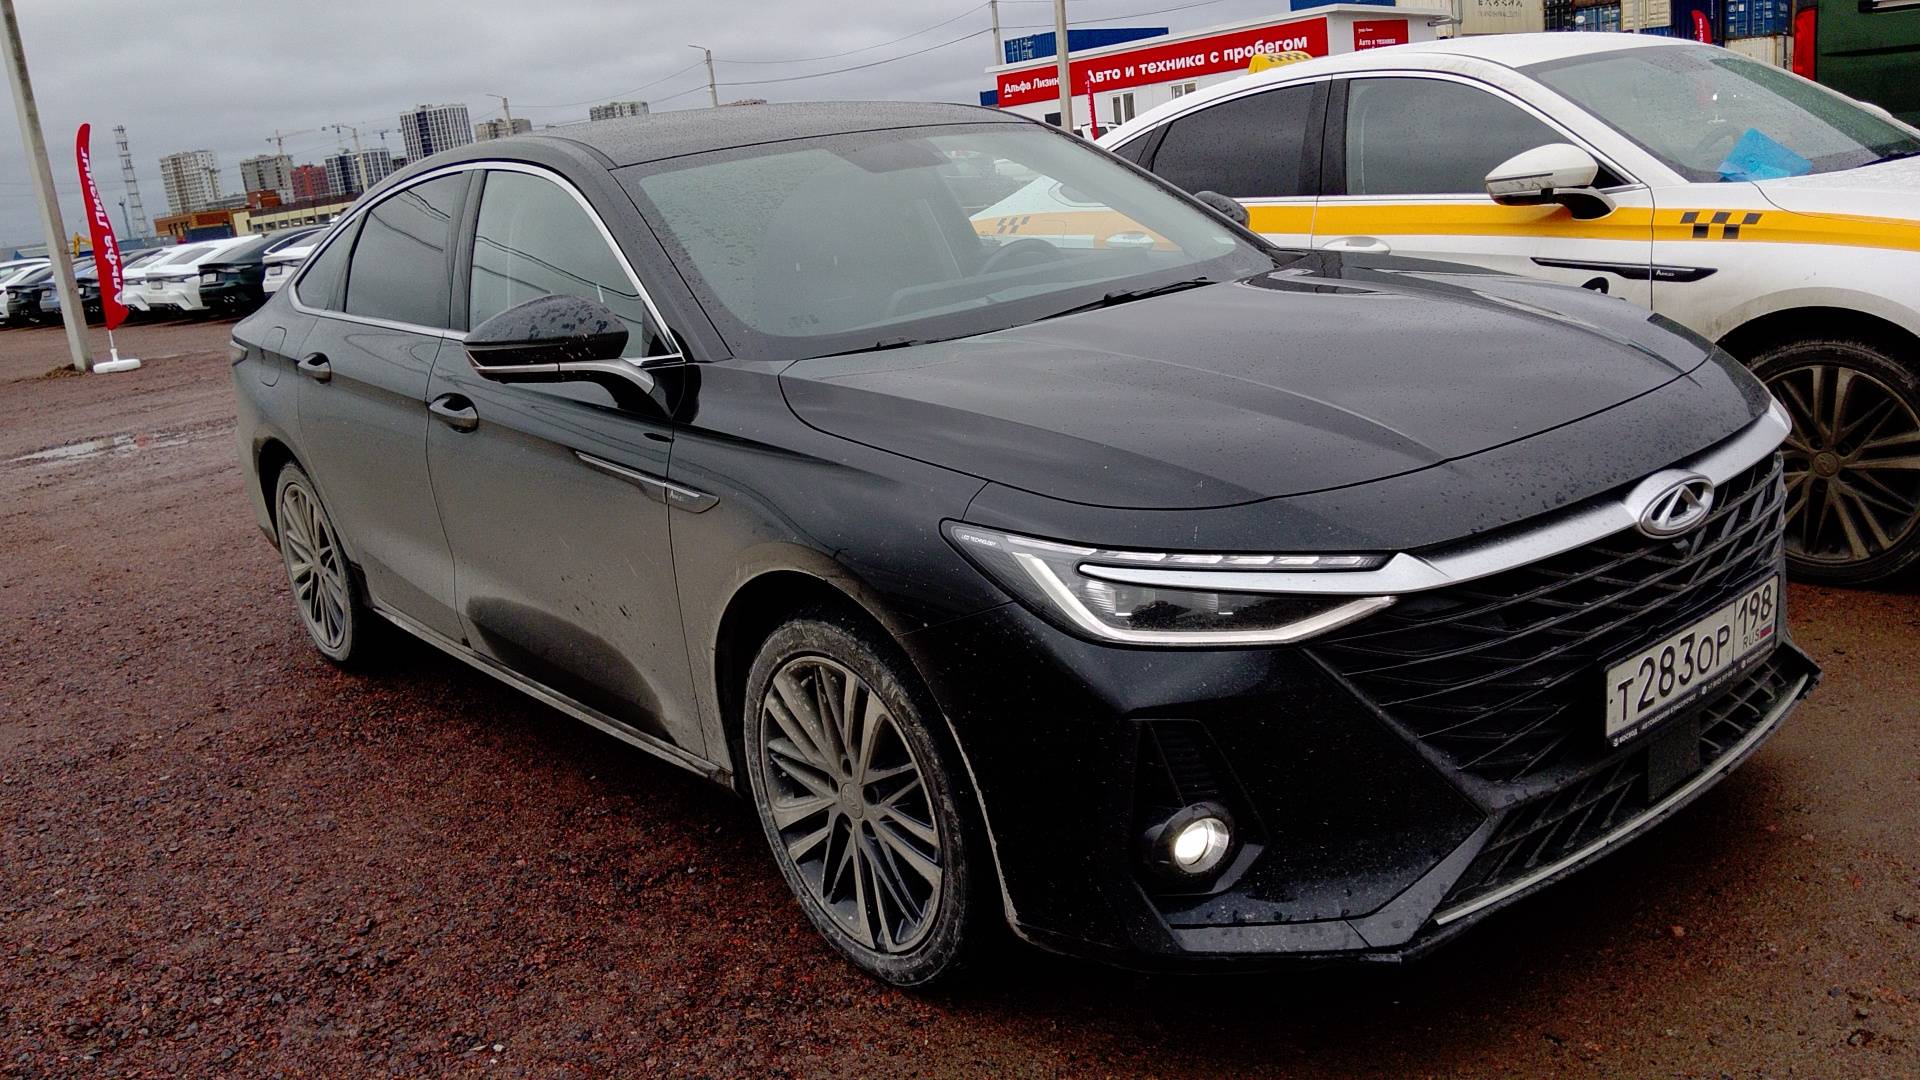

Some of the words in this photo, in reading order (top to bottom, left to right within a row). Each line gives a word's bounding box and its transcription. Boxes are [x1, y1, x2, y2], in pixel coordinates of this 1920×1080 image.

[1125, 64, 1135, 77] и
[1139, 53, 1205, 75] техника
[1209, 50, 1220, 62] с
[1223, 35, 1308, 64] пробегом
[1004, 79, 1032, 94] Альфа
[1033, 76, 1059, 90] Лизин
[81, 147, 109, 229] Лизинг
[104, 235, 123, 304] Альфа
[1738, 583, 1773, 636] 198
[1743, 628, 1761, 650] RUS
